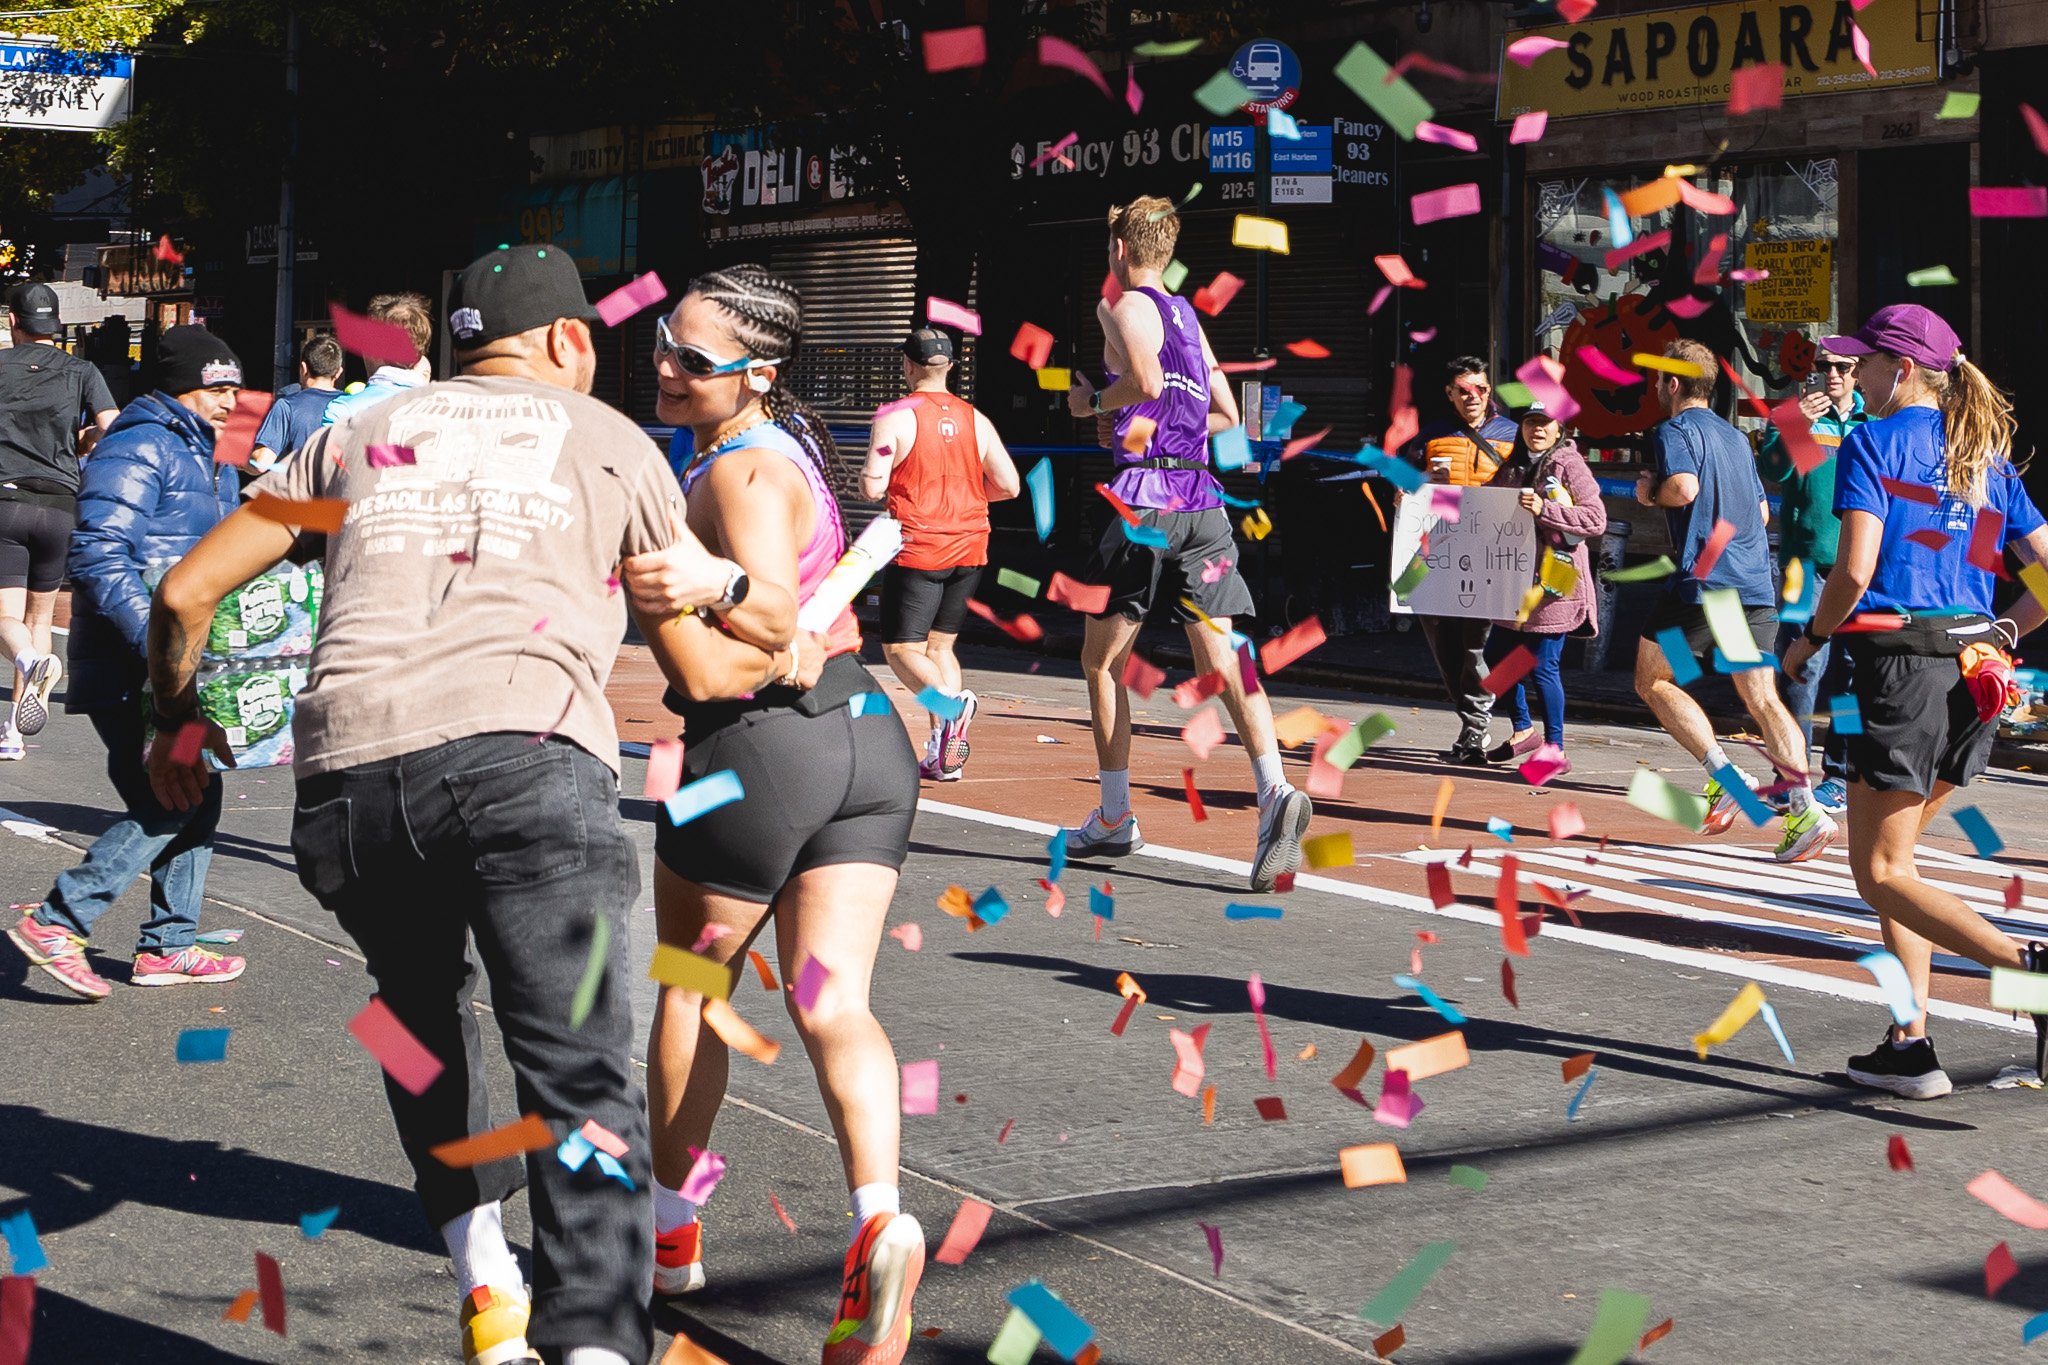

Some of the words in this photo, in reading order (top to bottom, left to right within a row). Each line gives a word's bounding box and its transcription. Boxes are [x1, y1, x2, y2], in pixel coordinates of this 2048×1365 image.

[1563, 0, 1865, 90] SAPOARA
[1248, 91, 1294, 114] STANDING
[1618, 91, 1654, 103] WOOD
[1658, 83, 1719, 100] ROASTING
[1212, 130, 1243, 147] M15
[1333, 116, 1383, 141] Fancy
[570, 145, 622, 170] PURITY
[1036, 139, 1115, 178] Fancy
[1122, 127, 1161, 168] 93
[1212, 152, 1252, 169] M116
[1274, 153, 1290, 161] East
[1291, 153, 1318, 161] Harlem
[1347, 142, 1370, 160] 93
[742, 146, 802, 206] DELI
[1281, 187, 1296, 196] 116
[1297, 187, 1304, 196] St
[1754, 243, 1788, 256] VOTERS
[1791, 240, 1816, 253] INFO
[524, 497, 575, 532] MATY
[1470, 511, 1482, 534] if
[1492, 521, 1524, 545] you
[1458, 555, 1474, 573] a
[1485, 543, 1529, 573] little
